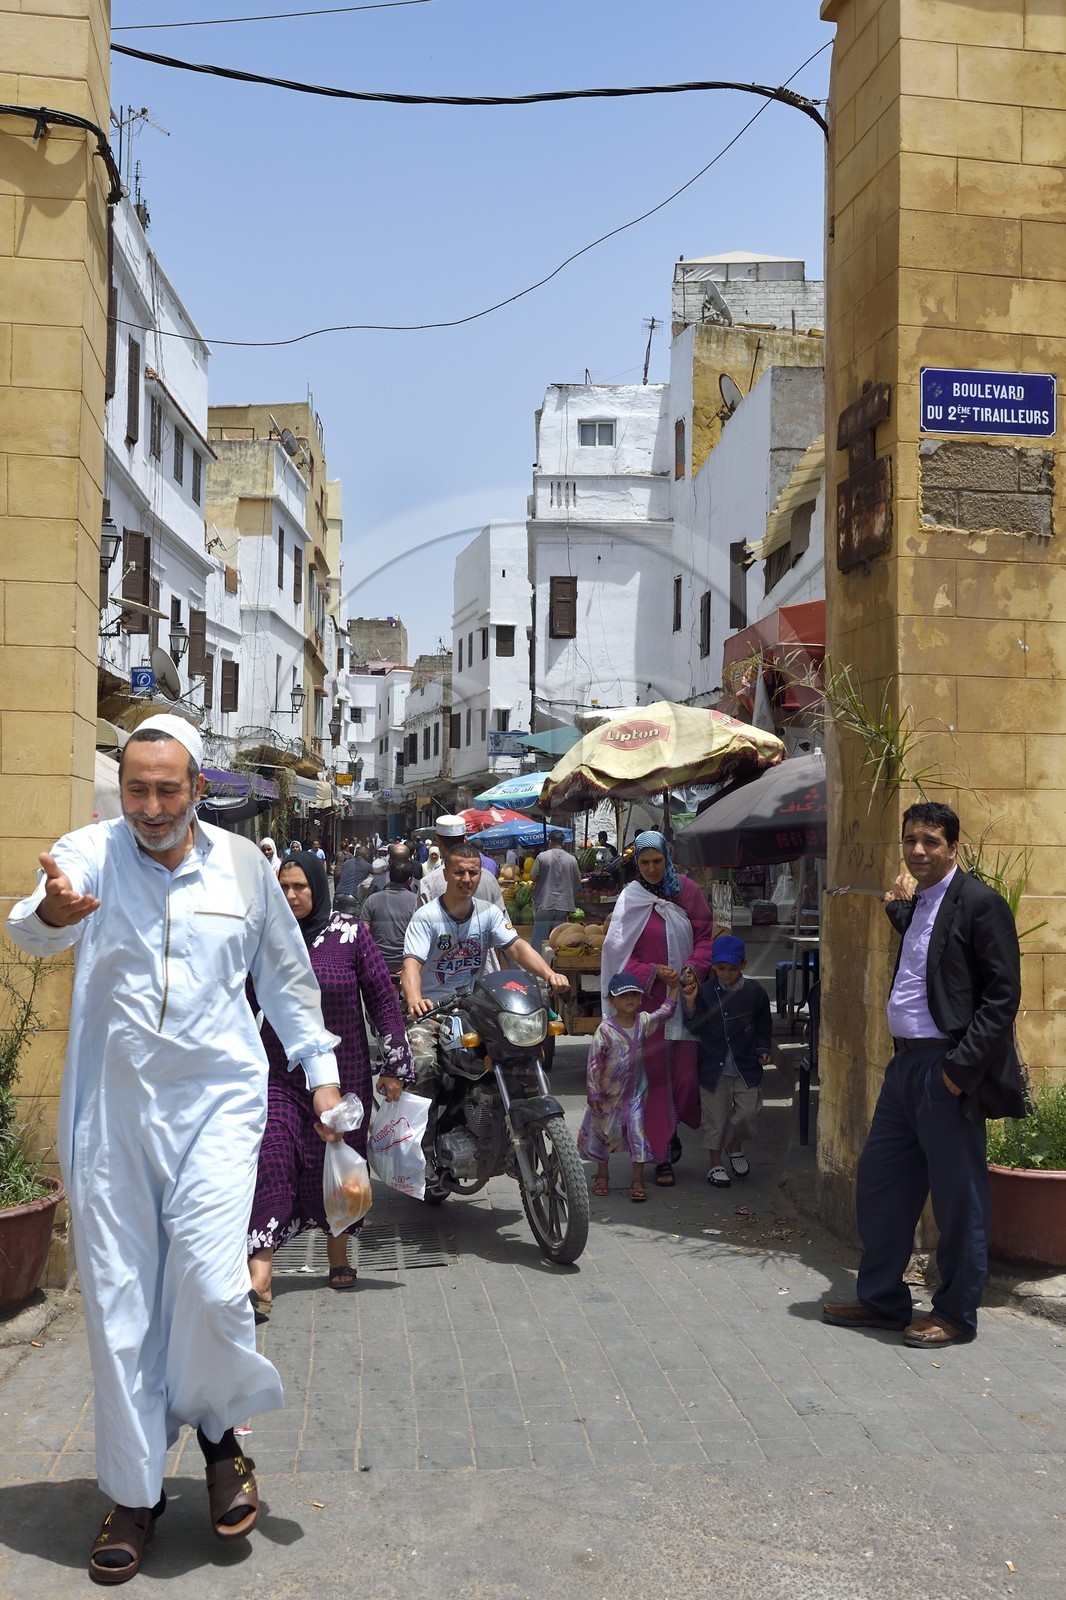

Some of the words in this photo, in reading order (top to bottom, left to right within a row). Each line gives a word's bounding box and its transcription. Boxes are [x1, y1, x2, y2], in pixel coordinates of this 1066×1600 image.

[953, 383, 1024, 401] BOULEVARD
[927, 405, 943, 419] DU
[972, 407, 1049, 425] TIRAILLEURS
[606, 728, 660, 743] Lipton
[776, 832, 790, 848] 06
[439, 942, 451, 950] 69
